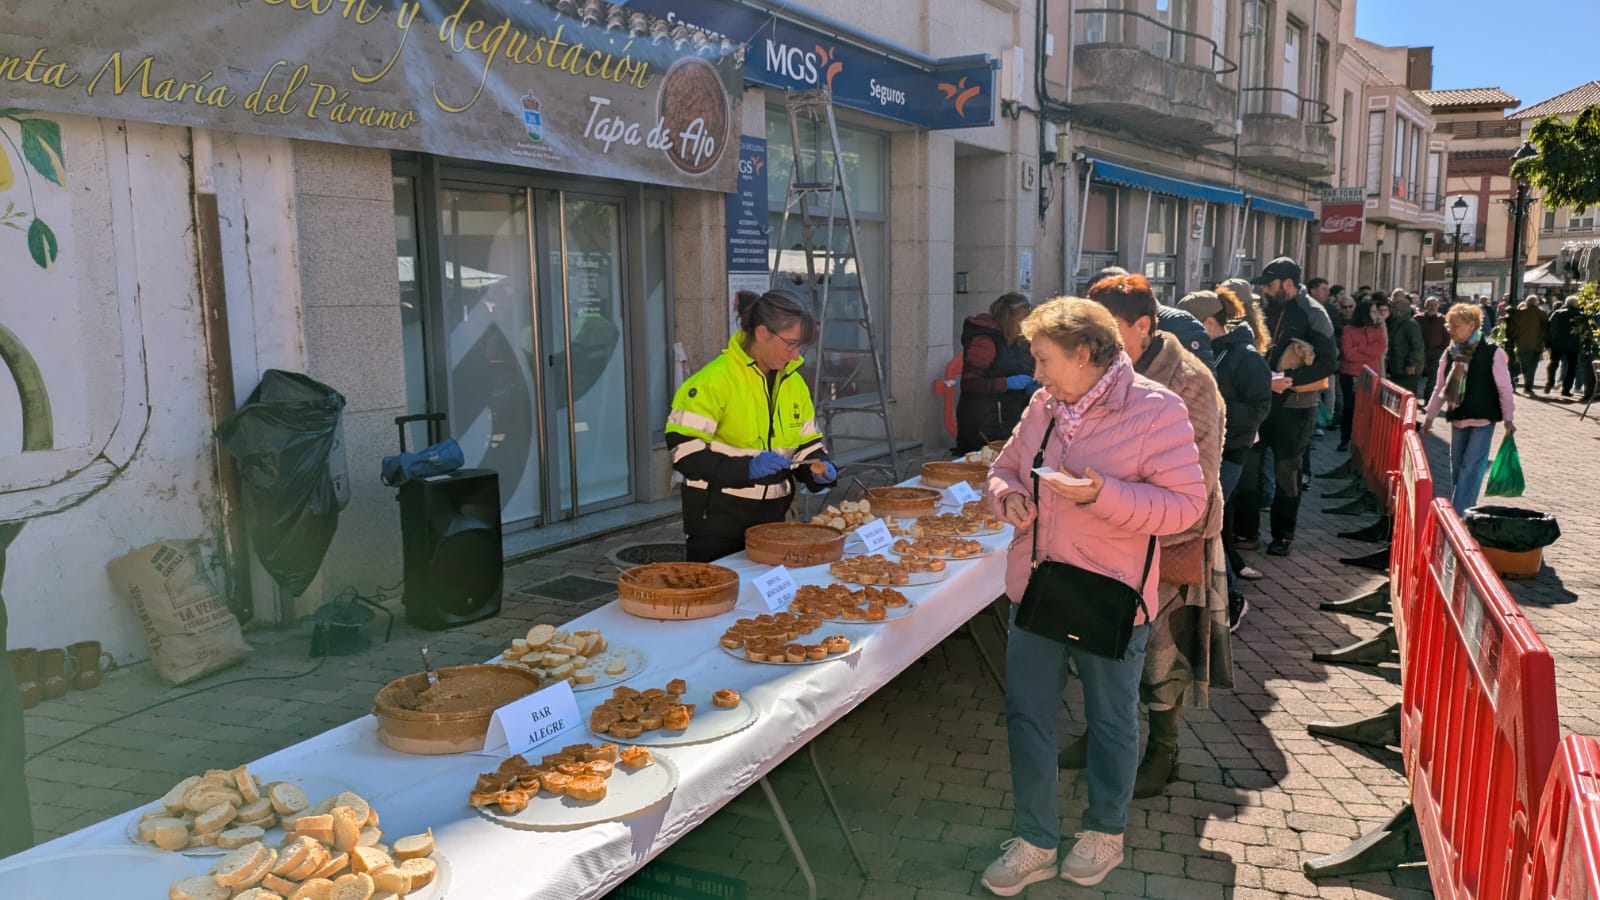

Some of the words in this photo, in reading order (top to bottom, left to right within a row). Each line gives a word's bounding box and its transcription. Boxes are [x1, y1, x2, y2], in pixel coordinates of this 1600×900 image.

[433, 0, 657, 113] degustación
[765, 39, 818, 84] MGS
[869, 78, 905, 106] Seguros
[0, 47, 79, 89] nta
[87, 51, 236, 108] María
[244, 60, 310, 116] del
[306, 81, 419, 131] Páramo
[583, 95, 641, 154] Tapa
[647, 116, 675, 151] de
[679, 117, 715, 170] Ajo
[738, 159, 753, 175] GS
[1027, 166, 1034, 187] 5
[1322, 215, 1360, 232] Coca-Cola
[531, 705, 552, 722] BAR
[528, 719, 566, 745] ALEGRE
